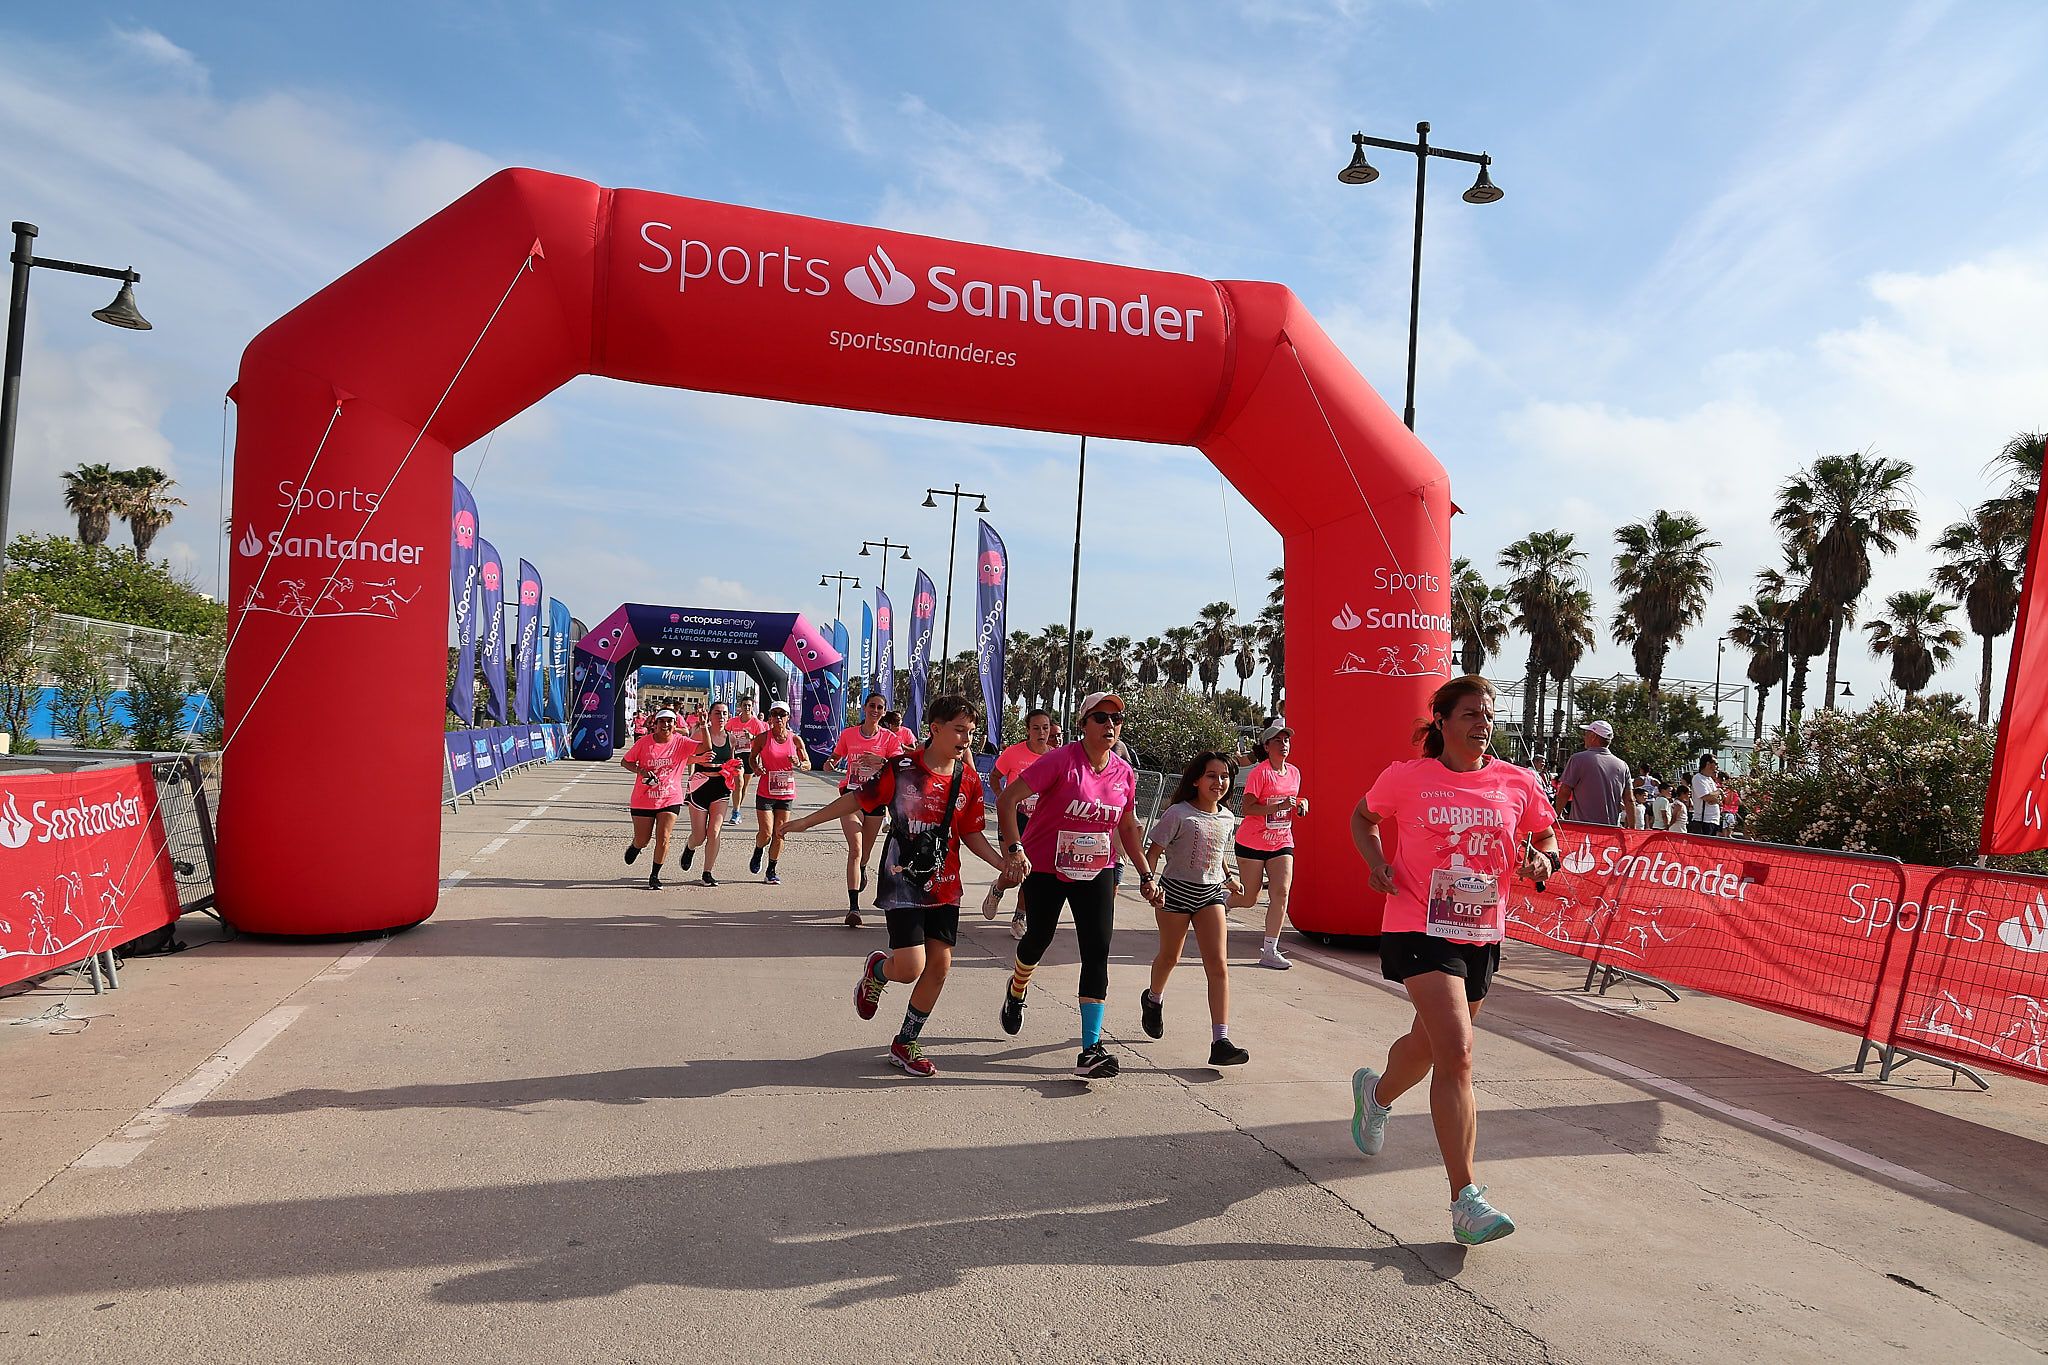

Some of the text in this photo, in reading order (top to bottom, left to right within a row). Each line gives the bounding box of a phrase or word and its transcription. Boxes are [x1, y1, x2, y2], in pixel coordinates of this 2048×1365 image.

[638, 221, 1204, 342] Sports Santander
[828, 328, 1017, 367] sportssantander.es
[277, 480, 380, 515] Sports
[267, 531, 424, 565] Santander
[1374, 567, 1440, 595] Sports
[1366, 608, 1452, 634] Santande
[680, 635, 721, 643] VELOCIDAD
[651, 646, 738, 660] VOLVO
[1420, 790, 1455, 799] OYSHO
[33, 792, 141, 843] Santander
[1428, 806, 1504, 828] CARRERA
[1468, 832, 1493, 856] DE
[1073, 854, 1094, 863] 016
[1596, 845, 1750, 903] Santander
[1454, 902, 1482, 916] 016
[1842, 883, 1989, 943] Sports
[1435, 927, 1460, 935] OYSHO
